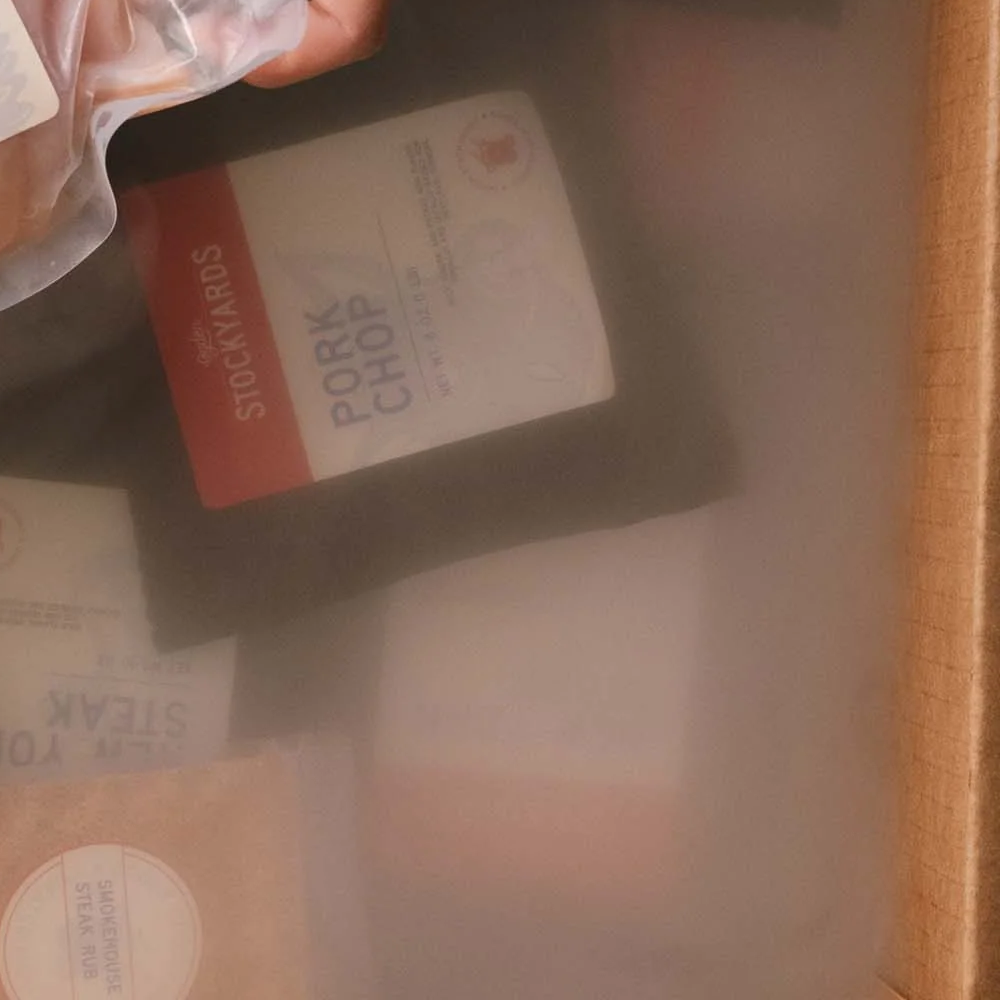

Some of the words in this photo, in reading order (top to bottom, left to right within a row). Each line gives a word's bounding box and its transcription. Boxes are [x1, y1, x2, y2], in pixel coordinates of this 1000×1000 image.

[188, 241, 269, 424] STOCKYARDS
[301, 302, 372, 429] PORK
[343, 287, 414, 418] CHOP
[46, 691, 187, 738] STEAK
[75, 881, 94, 936] STEAK
[80, 944, 98, 979] RUB
[97, 879, 122, 995] SMOKEHOUSE
